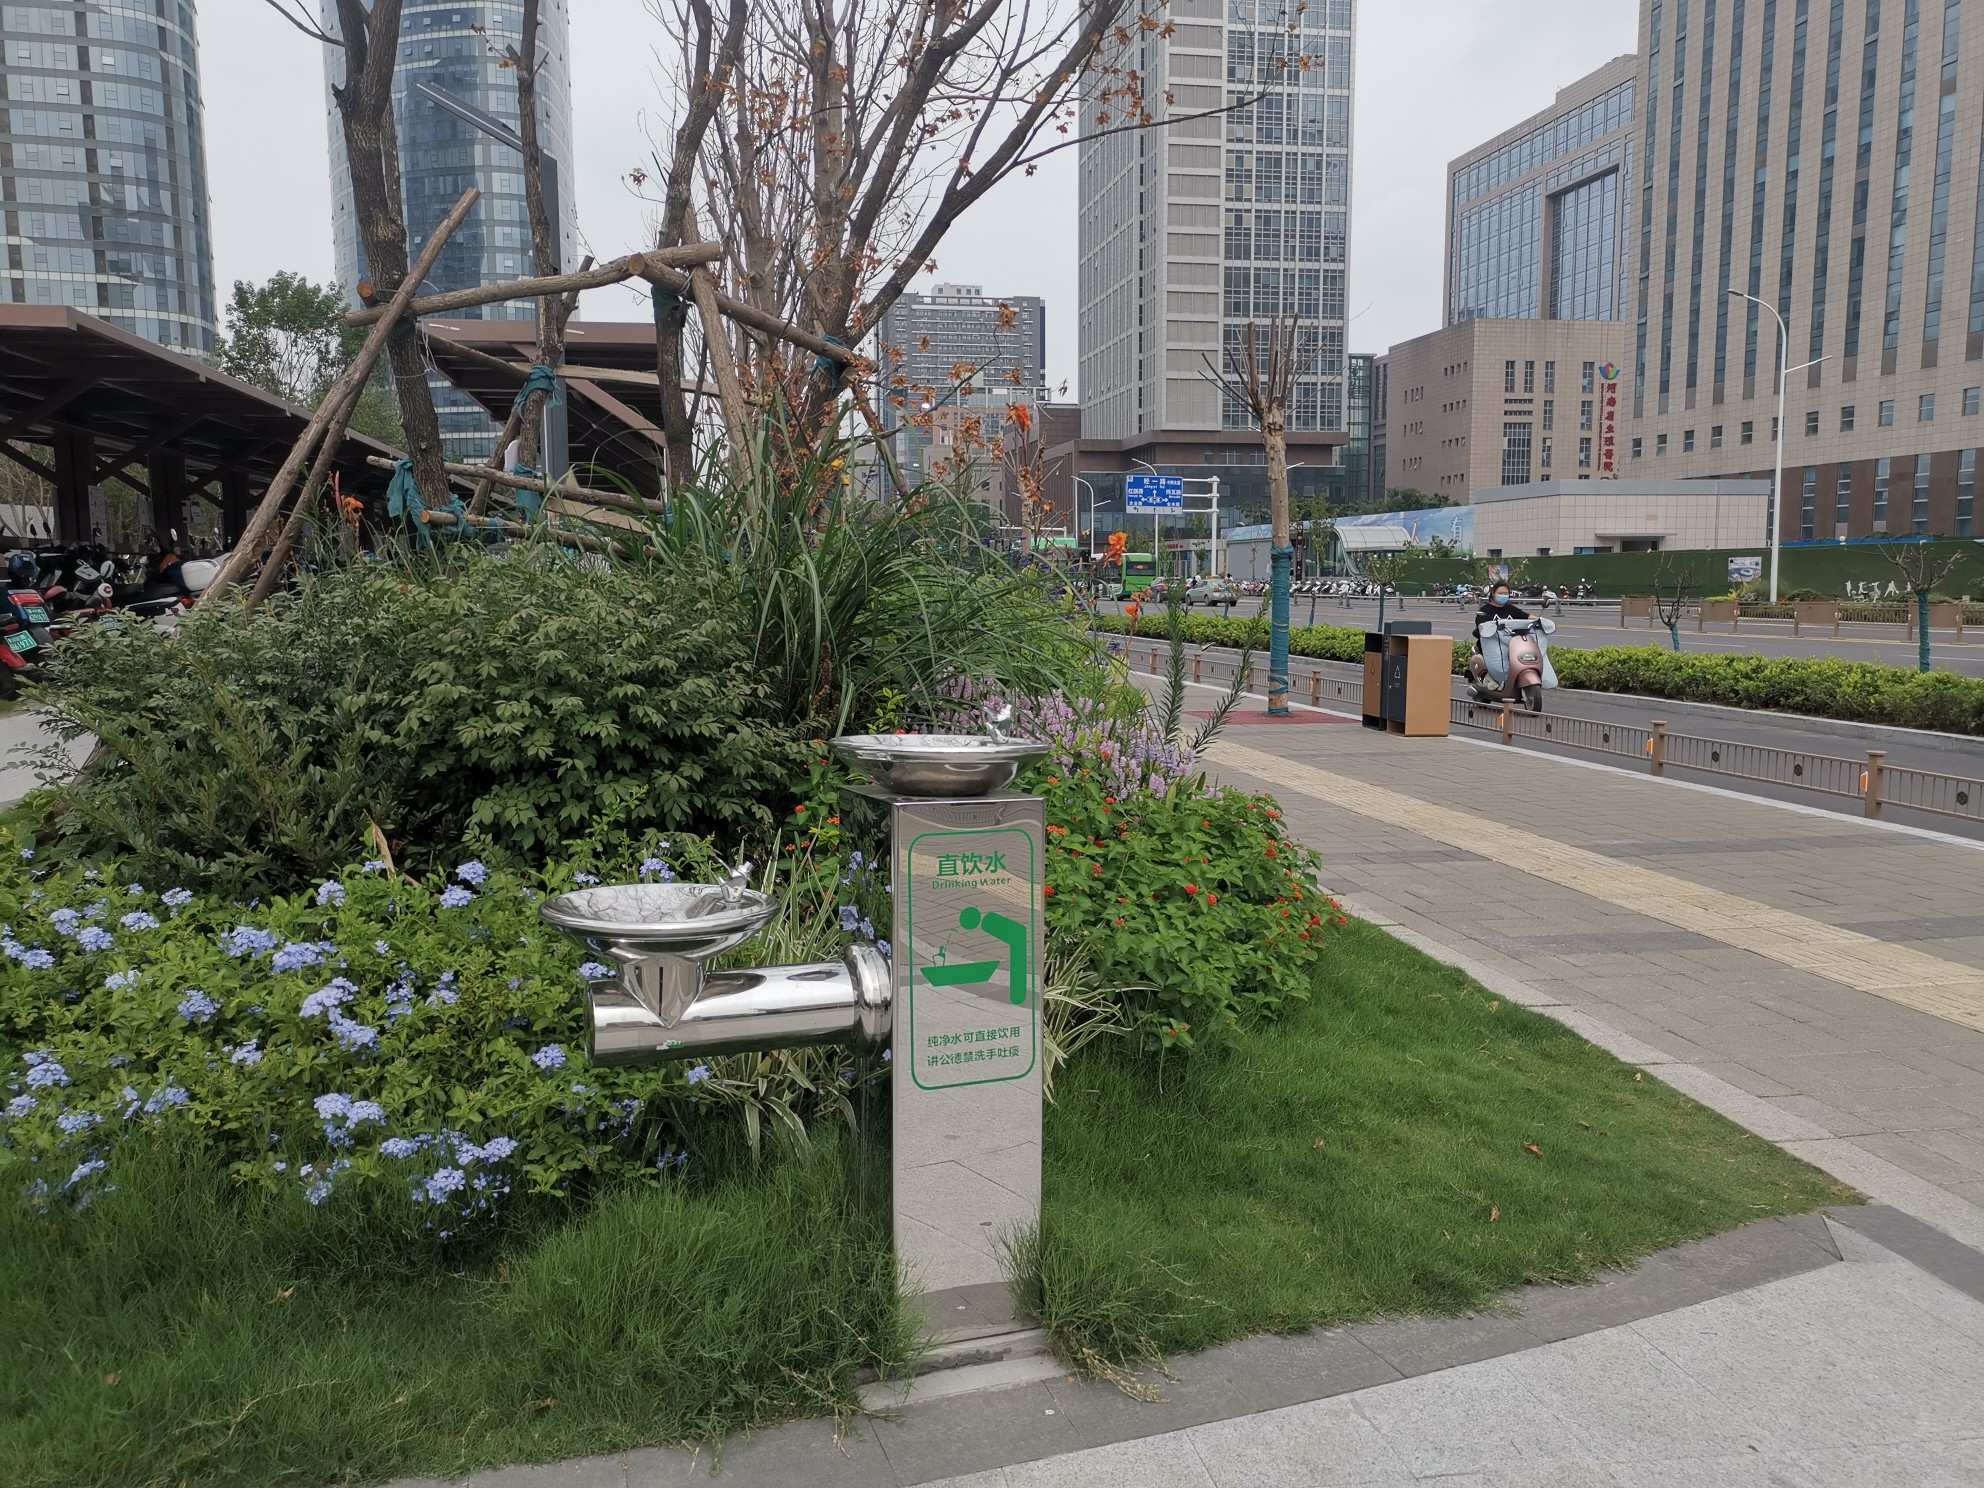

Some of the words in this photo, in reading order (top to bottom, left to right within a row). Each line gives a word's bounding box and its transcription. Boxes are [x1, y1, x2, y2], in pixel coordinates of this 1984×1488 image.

[937, 850, 1006, 876] 直饮水
[932, 879, 977, 889] Drinking
[980, 877, 1011, 886] Water
[927, 1026, 1020, 1047] 纯净水可直接饮用
[927, 1045, 1020, 1066] 讲公德禁洗手吐痰
